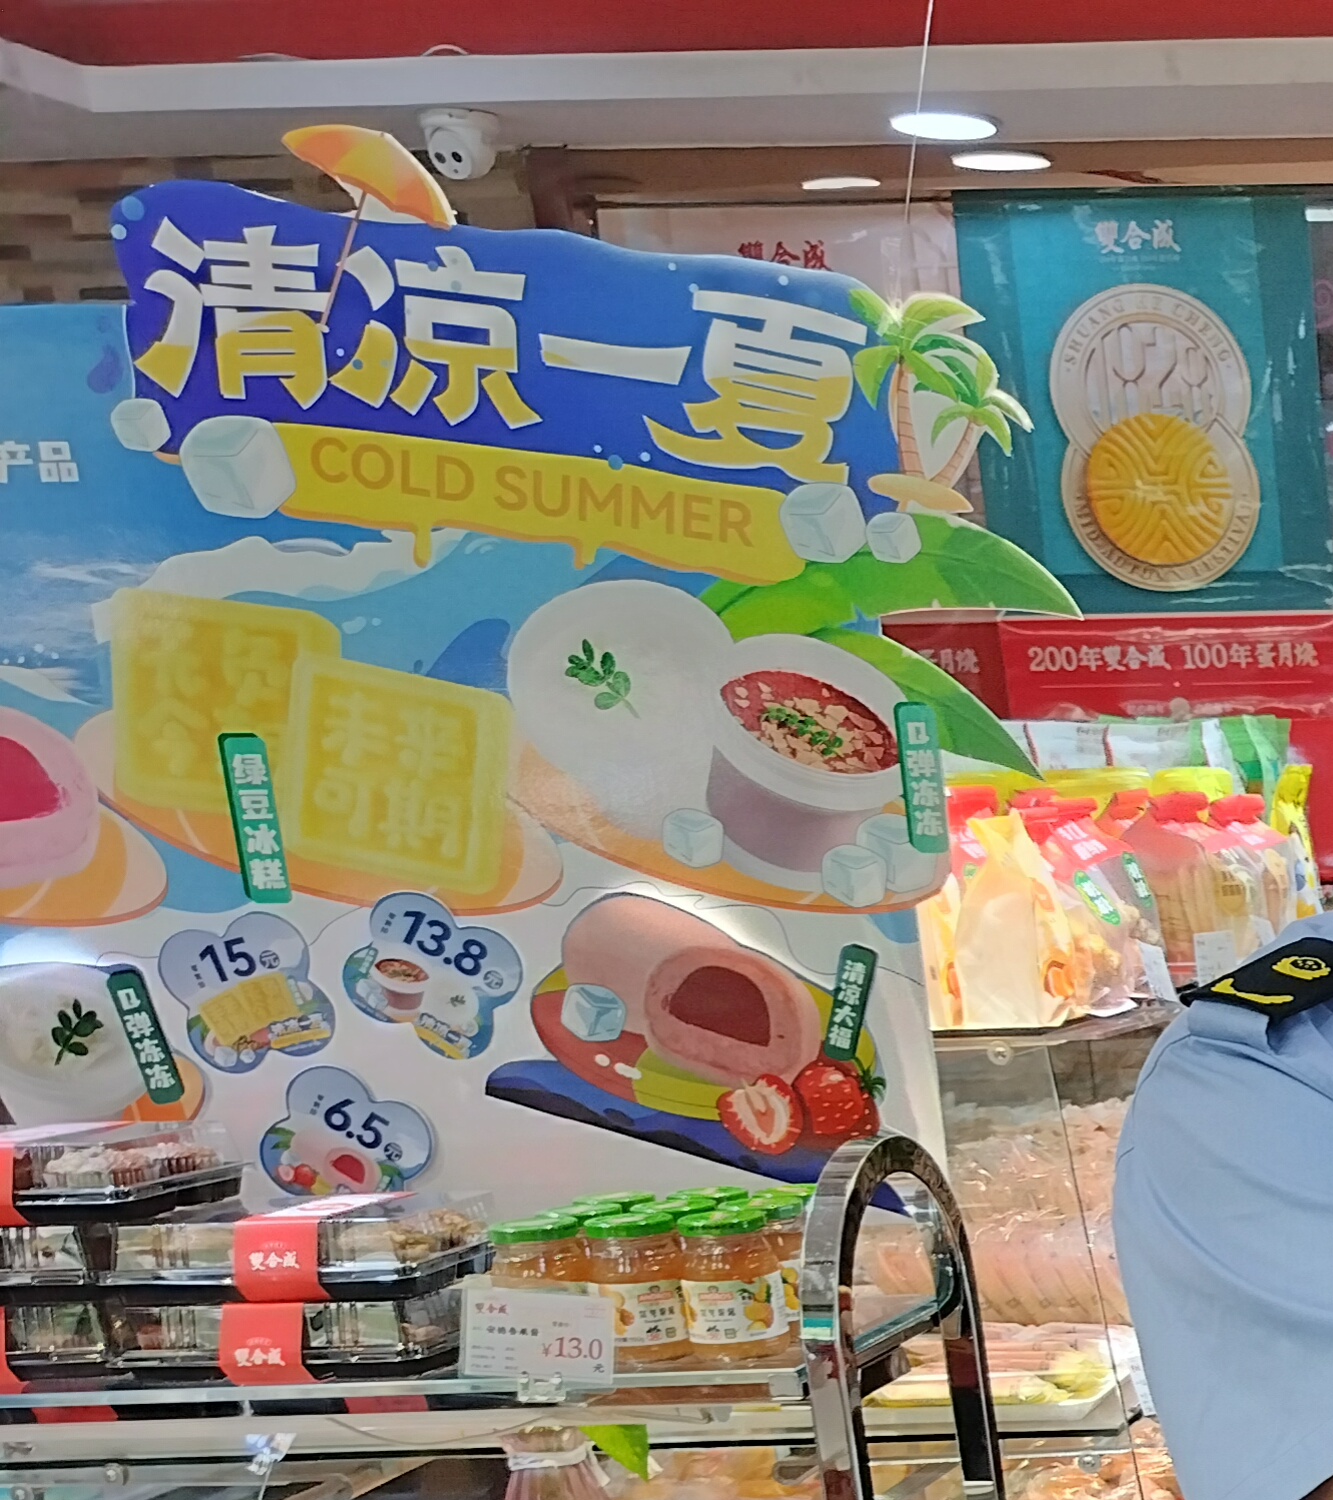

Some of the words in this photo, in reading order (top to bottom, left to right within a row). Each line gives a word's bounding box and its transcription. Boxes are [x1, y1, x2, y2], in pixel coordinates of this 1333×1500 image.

[1095, 219, 1182, 253] 雙合成
[134, 217, 866, 484] 清凉一夏
[1064, 299, 1125, 365] SHUANG
[309, 437, 475, 501] COLD
[494, 464, 753, 547] SUMMER
[232, 754, 287, 889] 绿豆冰糕
[199, 937, 256, 982] 15
[403, 910, 488, 976] 13.8
[827, 959, 868, 1050] 清凉大福
[324, 1098, 389, 1148] 6.5
[249, 1249, 300, 1270] 雙合成
[235, 1346, 285, 1367] 雙合成
[542, 1337, 603, 1359] ¥13.0
